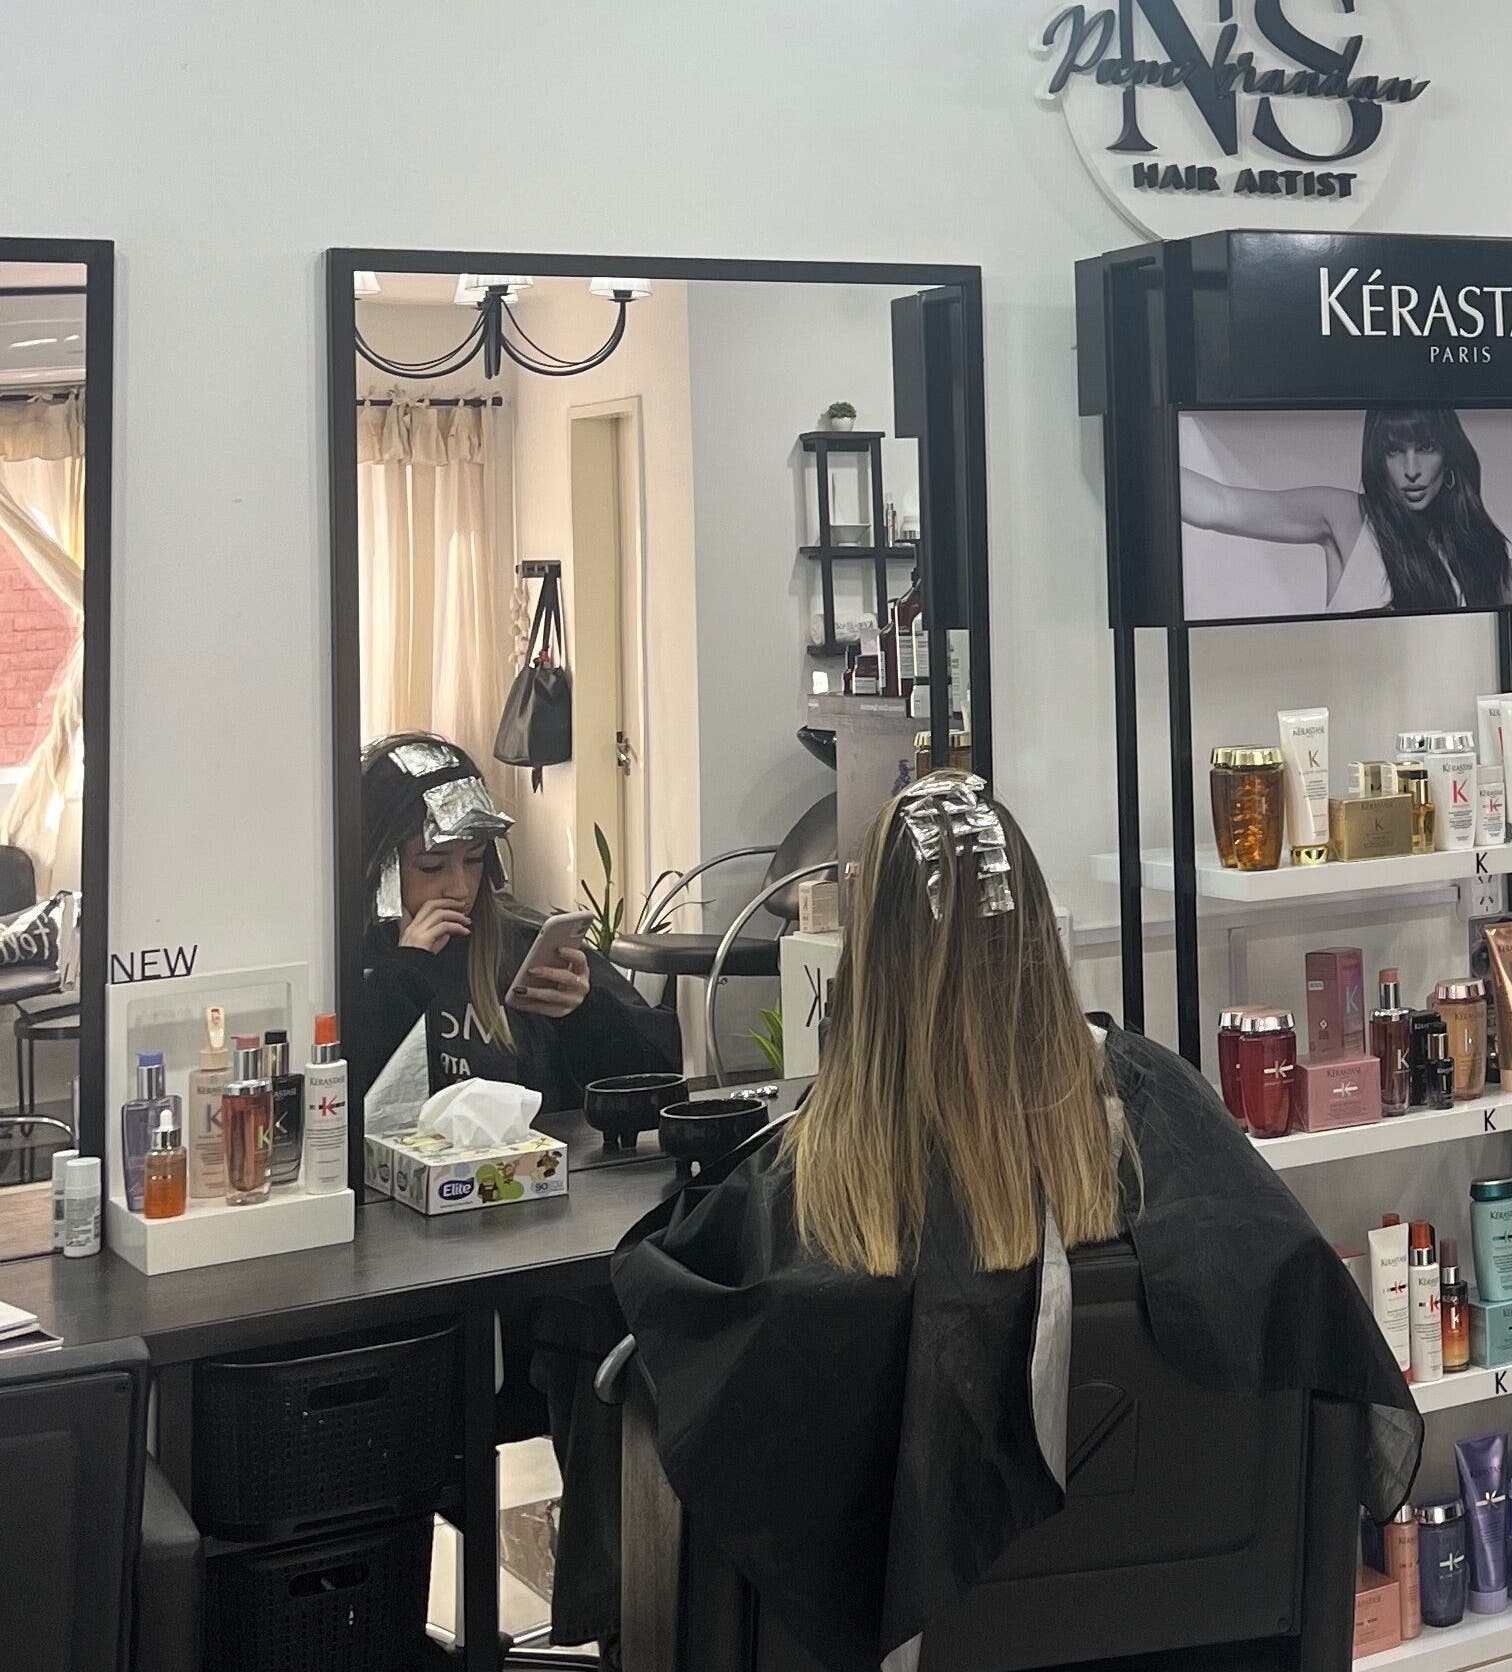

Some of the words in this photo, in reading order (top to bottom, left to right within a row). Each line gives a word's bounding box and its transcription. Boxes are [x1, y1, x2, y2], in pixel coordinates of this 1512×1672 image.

[1132, 162, 1220, 190] HAIR
[1234, 167, 1357, 198] ARTIST
[1430, 345, 1492, 364] PARIS
[1309, 750, 1320, 768] K
[1453, 779, 1468, 803] K
[1375, 815, 1384, 831] K
[1476, 852, 1488, 874] K
[111, 945, 197, 984] NEW
[1397, 1048, 1409, 1070] K
[1484, 1108, 1497, 1132] K
[258, 1125, 270, 1149] K
[443, 1183, 471, 1197] Elite
[1496, 1371, 1508, 1394] K
